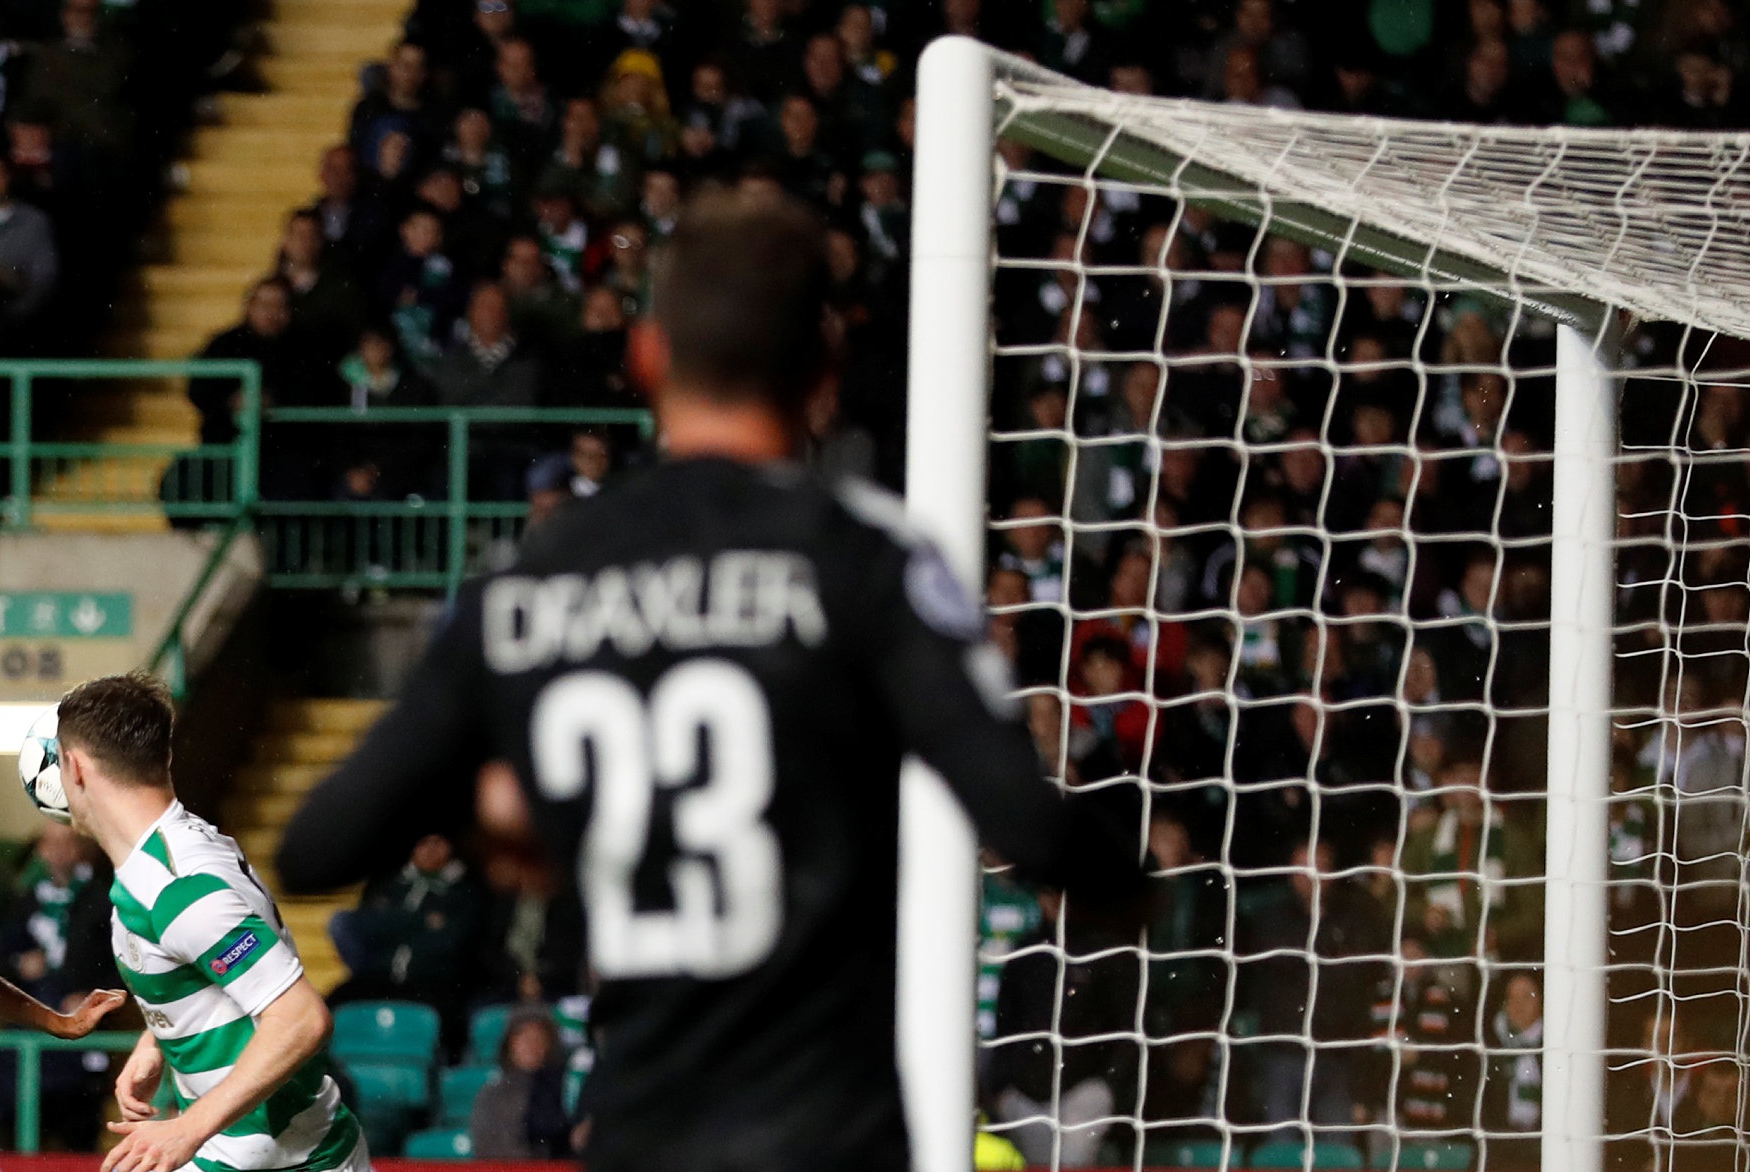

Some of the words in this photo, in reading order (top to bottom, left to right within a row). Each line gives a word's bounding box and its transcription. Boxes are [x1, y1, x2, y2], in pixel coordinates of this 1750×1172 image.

[481, 548, 827, 674] DRAXLER
[530, 657, 783, 980] 23
[222, 933, 257, 965] RESPECT
